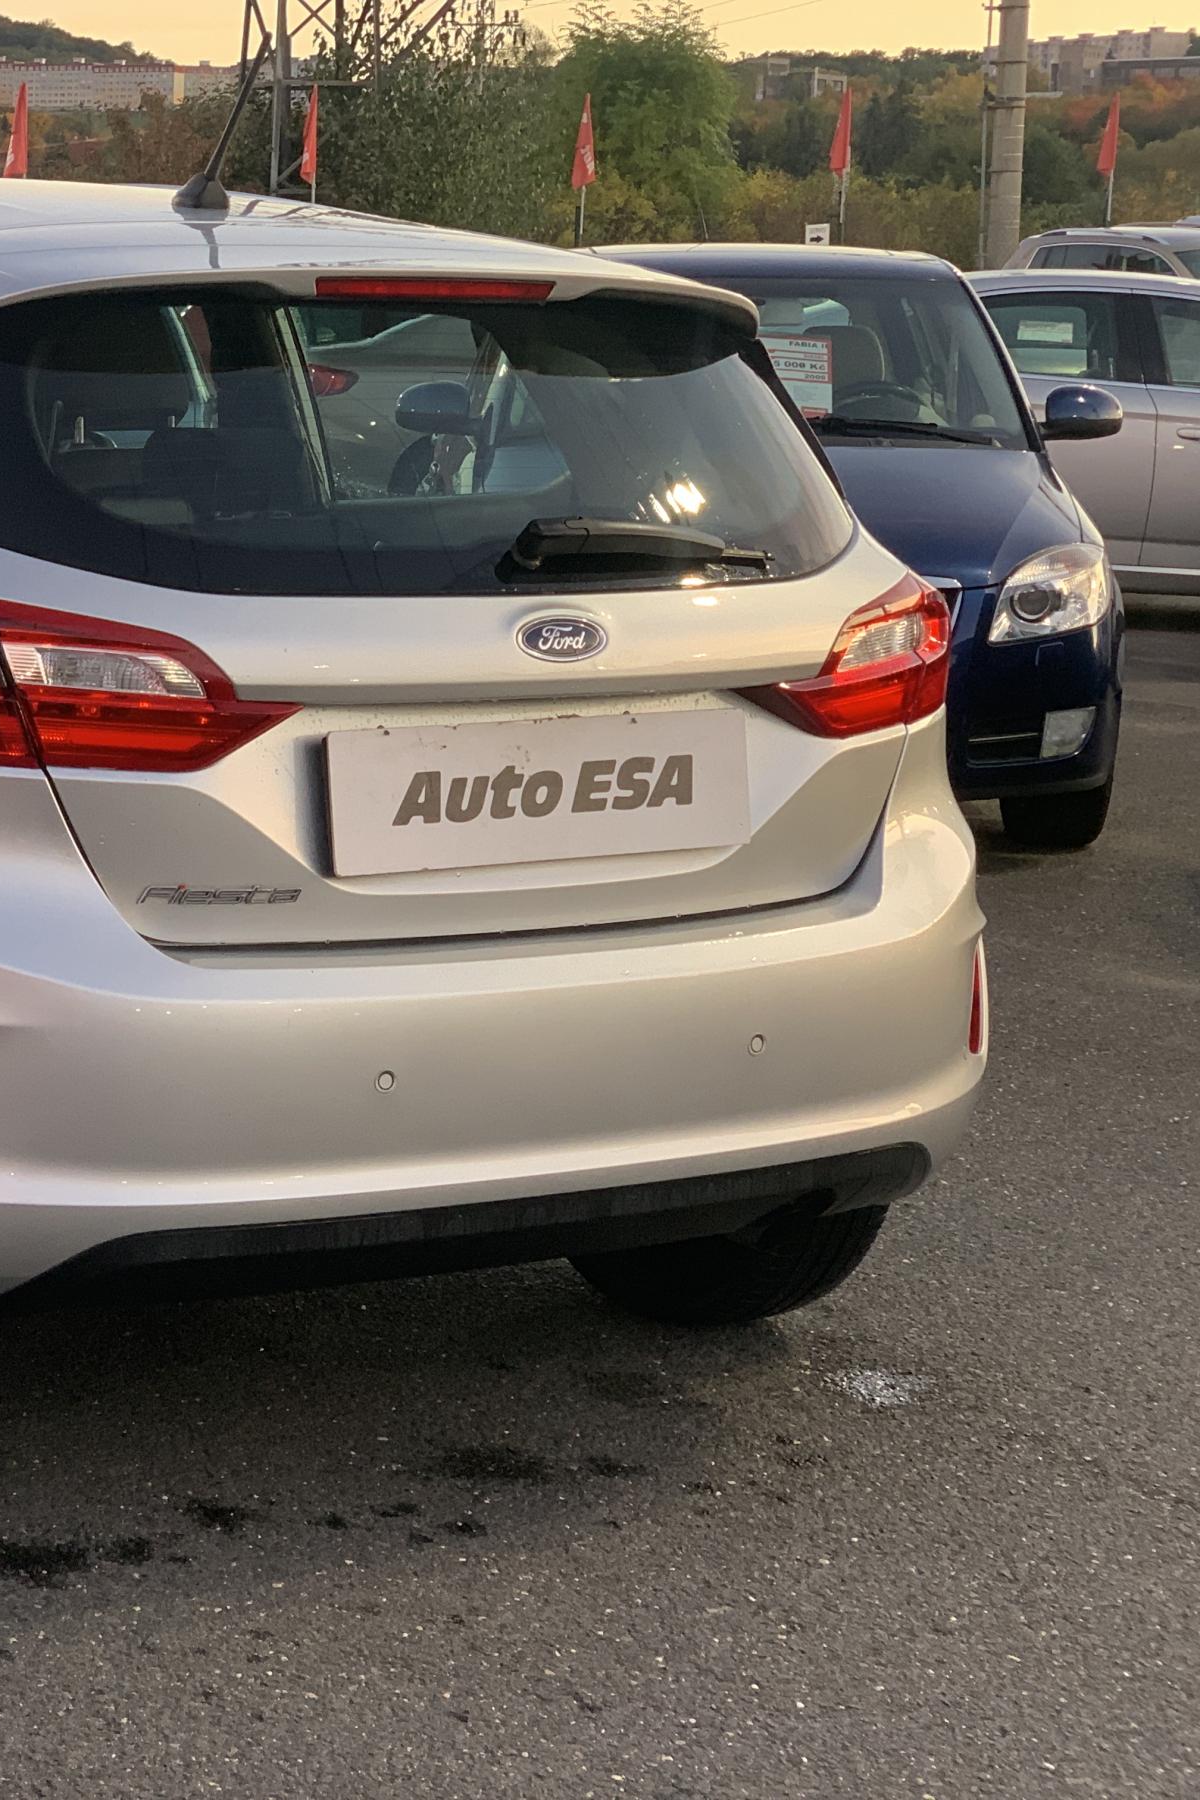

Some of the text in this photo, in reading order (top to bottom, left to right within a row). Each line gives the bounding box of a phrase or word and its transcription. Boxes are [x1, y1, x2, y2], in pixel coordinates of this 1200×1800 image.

[789, 341, 818, 349] FABIA
[538, 625, 586, 650] Ford
[391, 753, 694, 827] Auto ESA
[136, 884, 302, 905] Fiesta
